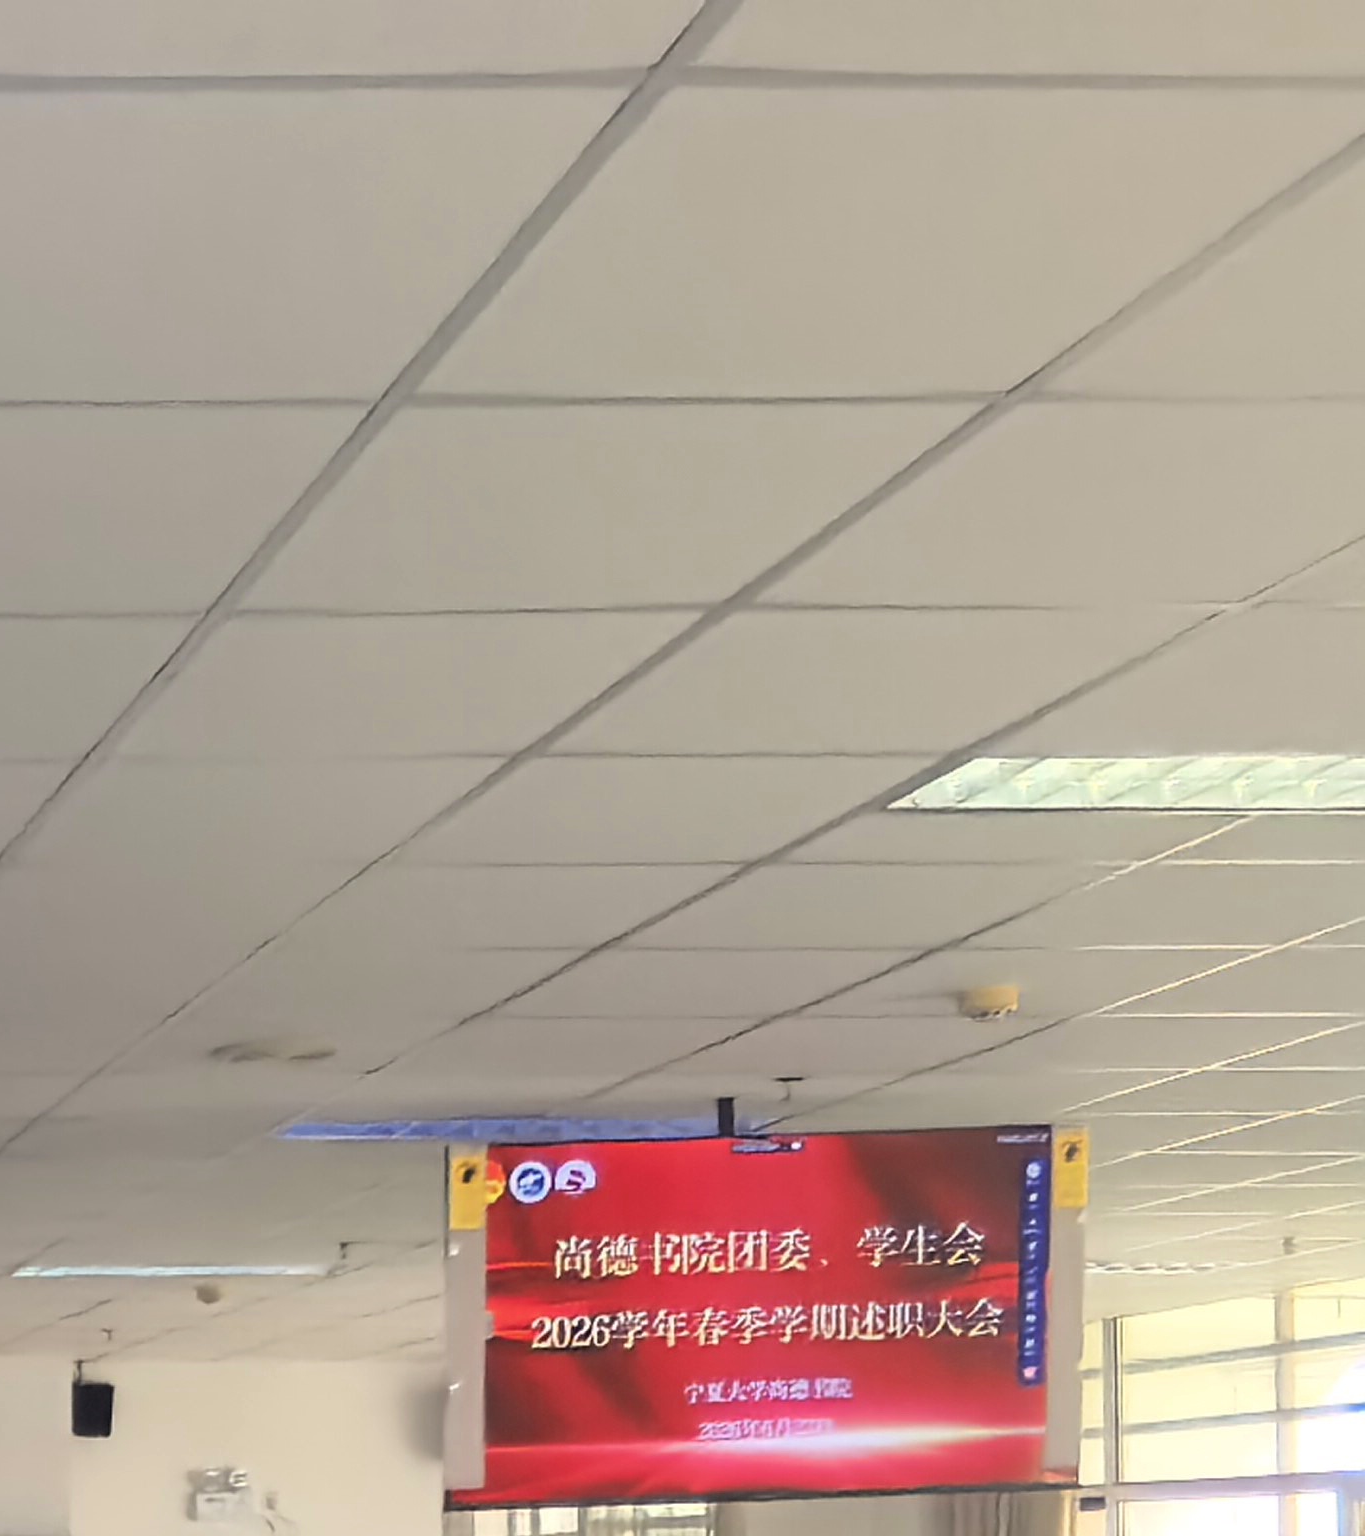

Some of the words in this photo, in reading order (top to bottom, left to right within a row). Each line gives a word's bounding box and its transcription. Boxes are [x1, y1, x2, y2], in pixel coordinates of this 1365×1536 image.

[553, 1222, 986, 1280] 尚德书院团委、学生会
[530, 1297, 1005, 1350] 2026学年春季学期述职大会
